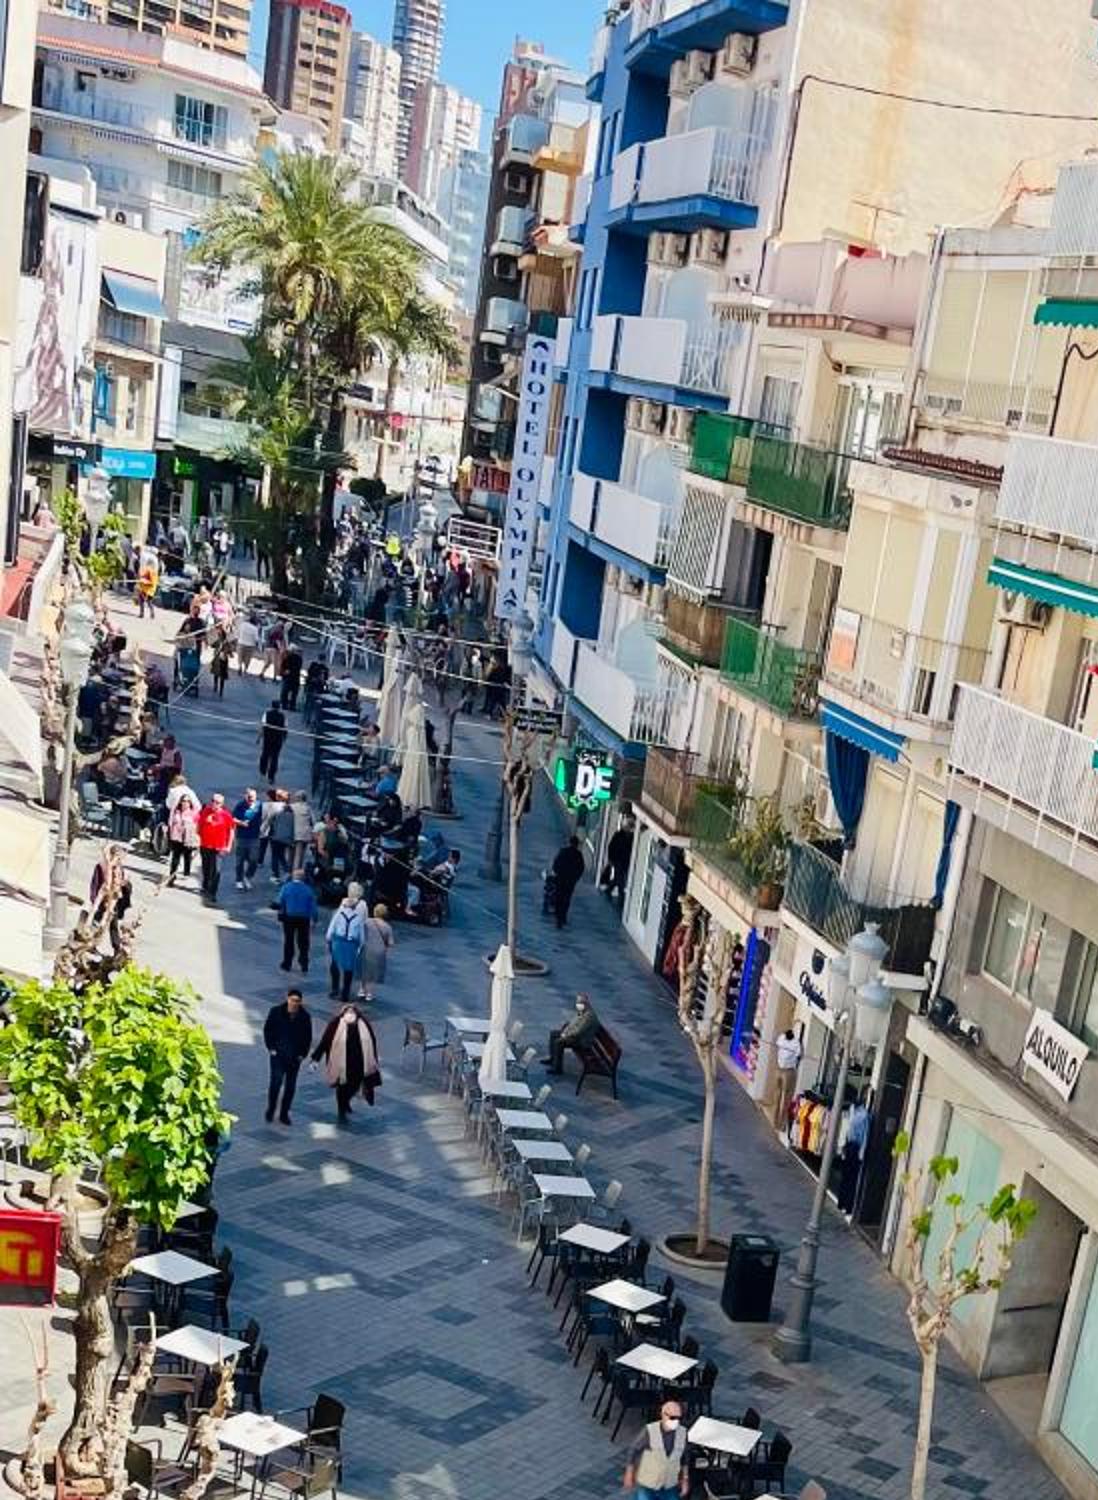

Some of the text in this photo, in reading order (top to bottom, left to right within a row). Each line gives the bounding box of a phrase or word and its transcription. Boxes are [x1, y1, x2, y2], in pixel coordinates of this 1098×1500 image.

[503, 359, 546, 600] HOTEL OLYMPIA
[1025, 1025, 1078, 1087] ALQUILO
